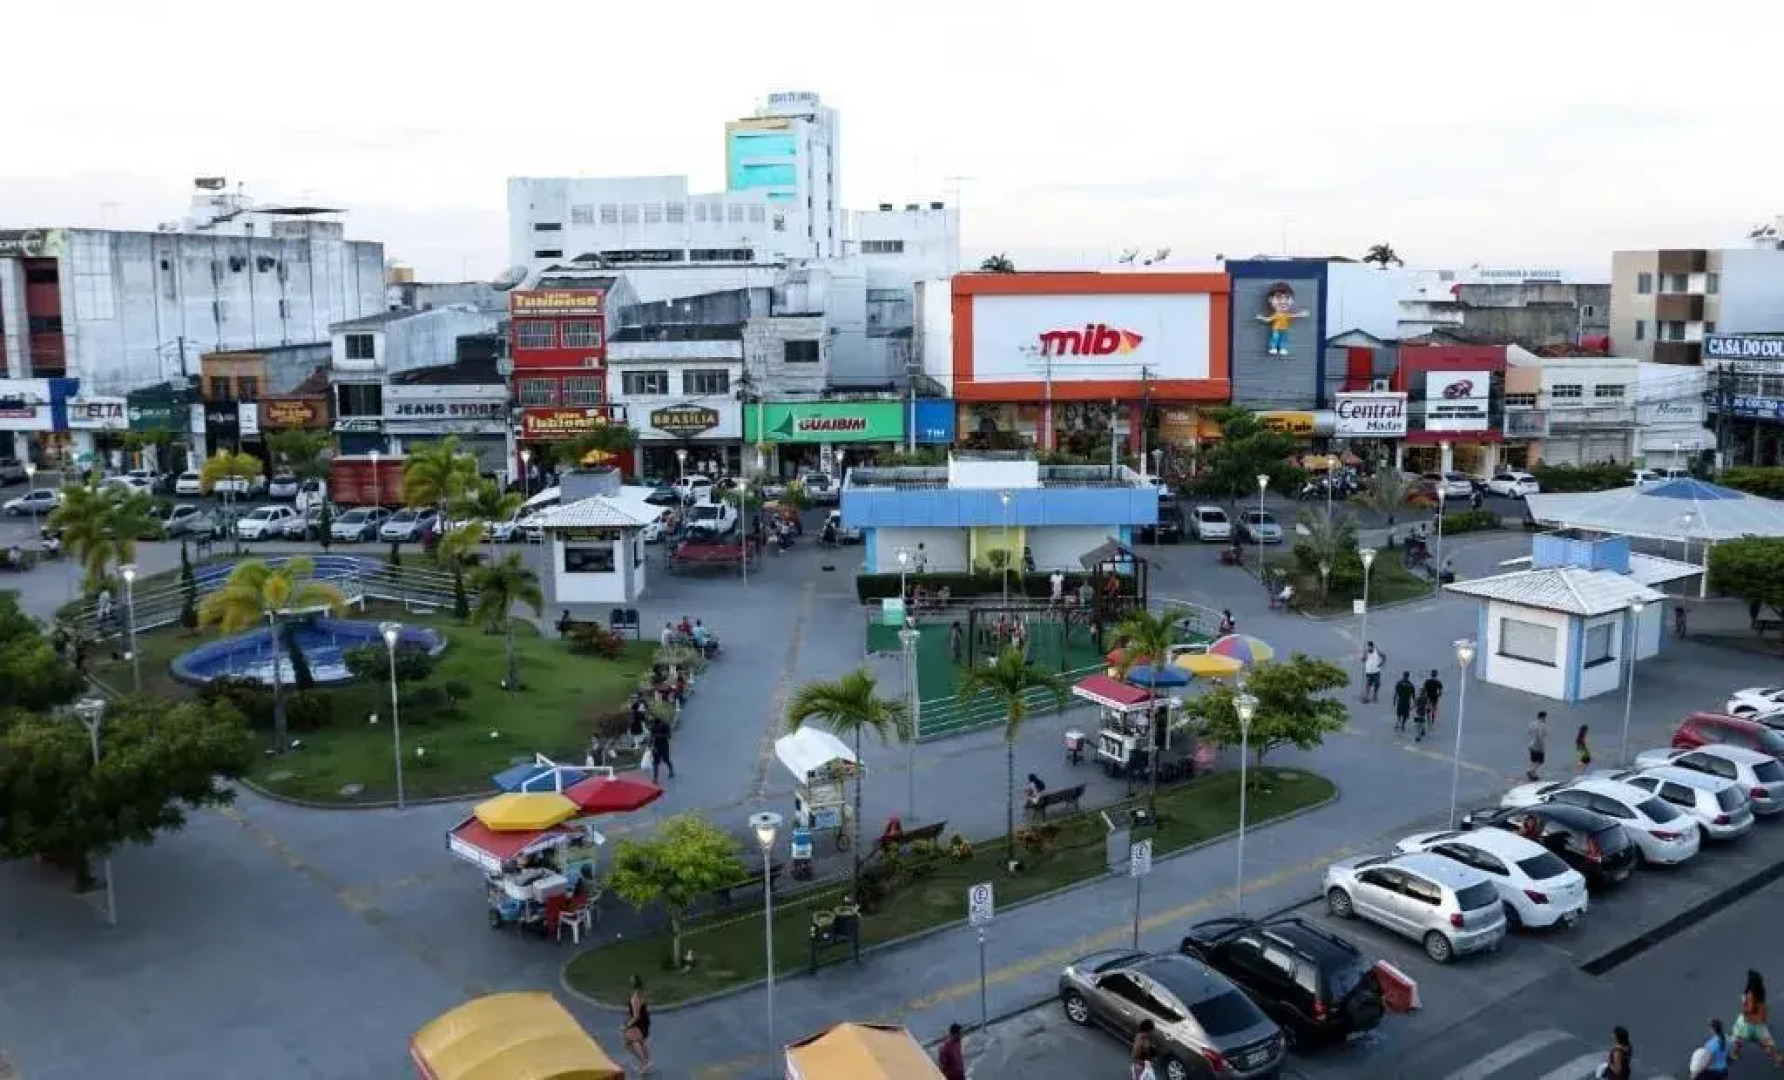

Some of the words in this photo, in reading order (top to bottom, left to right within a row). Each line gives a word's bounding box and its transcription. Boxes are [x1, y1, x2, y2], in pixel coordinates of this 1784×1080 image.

[1039, 323, 1121, 356] mib
[1708, 337, 1740, 356] CASA
[1743, 338, 1760, 356] DO
[395, 403, 445, 415] JEANS
[1337, 399, 1403, 419] Central
[798, 417, 867, 431] GUAIBIM
[926, 429, 945, 437] TIM
